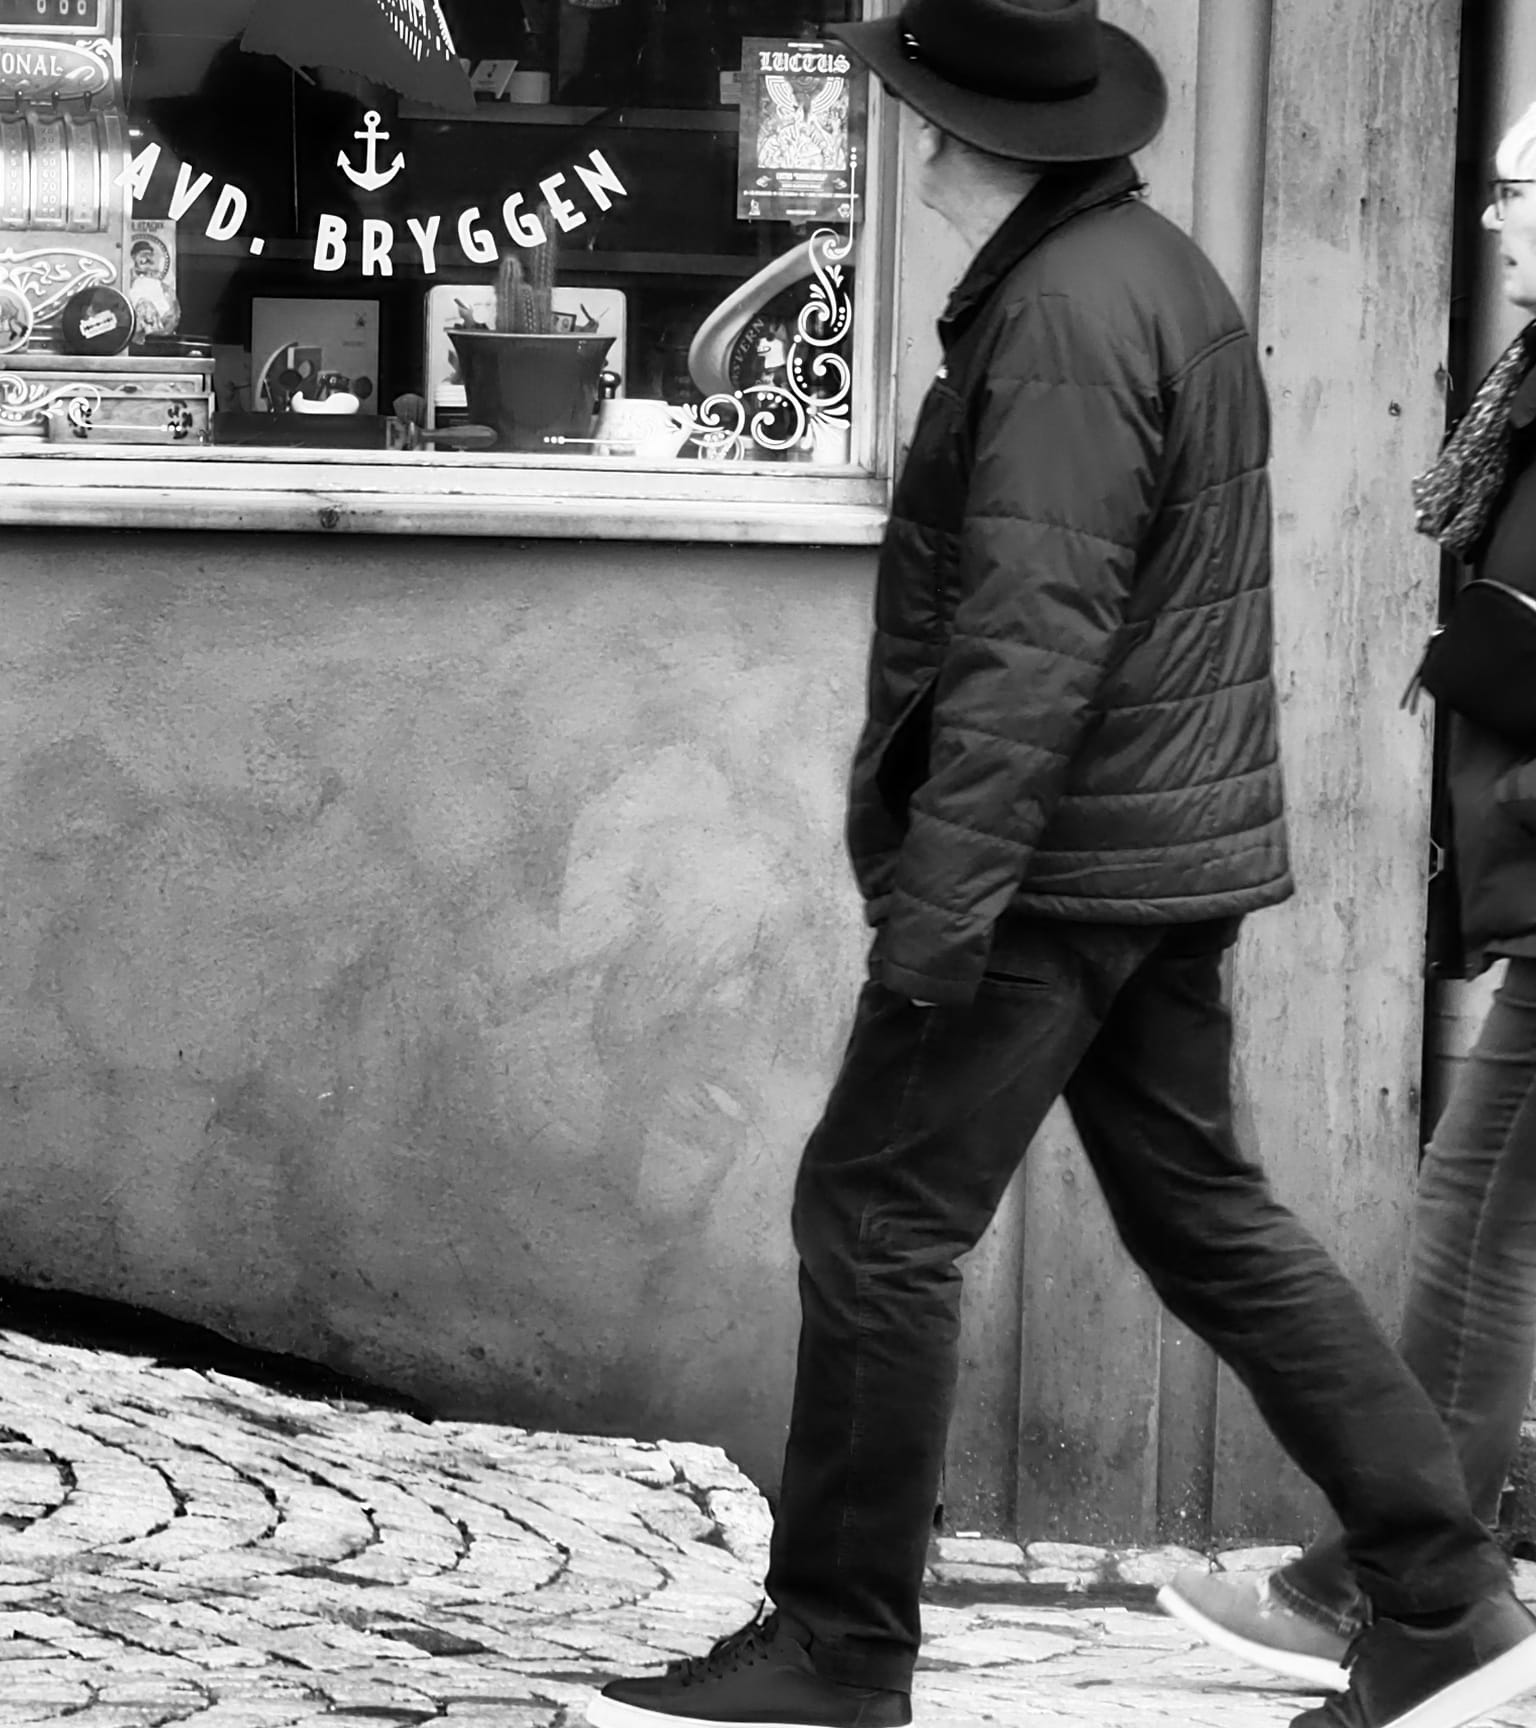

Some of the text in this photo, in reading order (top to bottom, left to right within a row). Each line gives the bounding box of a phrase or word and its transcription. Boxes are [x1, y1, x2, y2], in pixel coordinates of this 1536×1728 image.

[758, 51, 852, 74] LUCTUS
[113, 142, 628, 277] AVD. BRYGGEN
